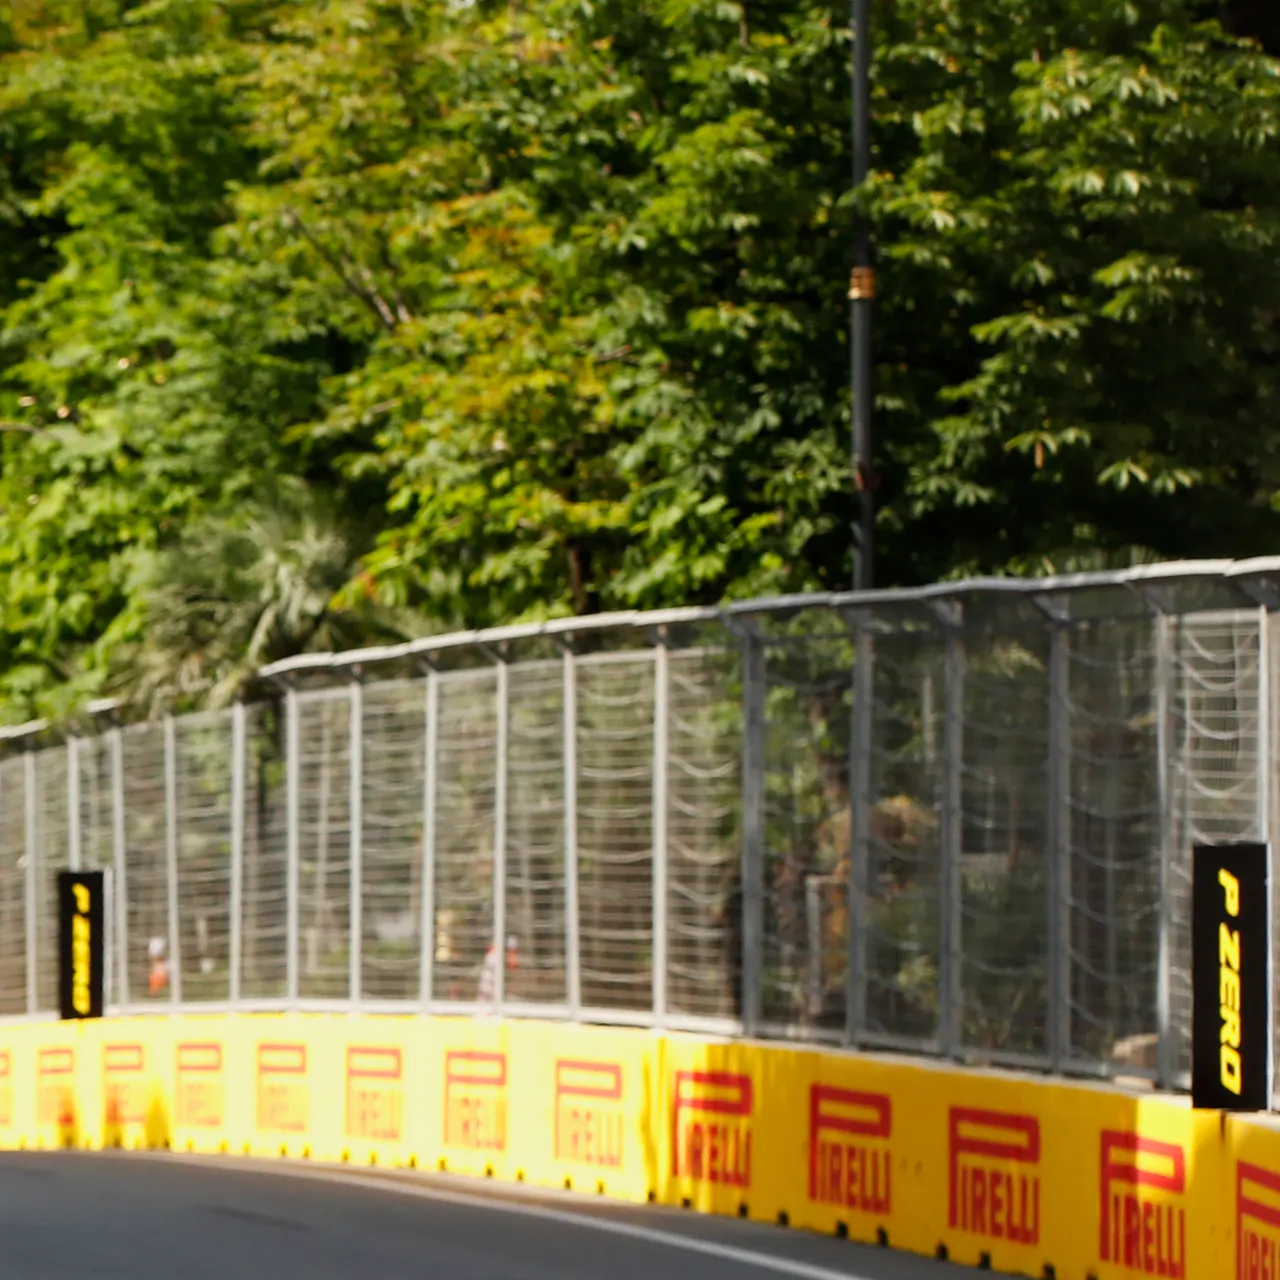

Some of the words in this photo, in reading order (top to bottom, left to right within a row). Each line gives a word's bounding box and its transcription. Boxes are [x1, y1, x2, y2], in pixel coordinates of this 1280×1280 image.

[1218, 867, 1240, 917] P
[1218, 922, 1242, 1095] ZERO
[674, 1071, 753, 1188] PIRELLI
[808, 1082, 893, 1215] PIRELLI
[948, 1105, 1040, 1245] PIRELLI
